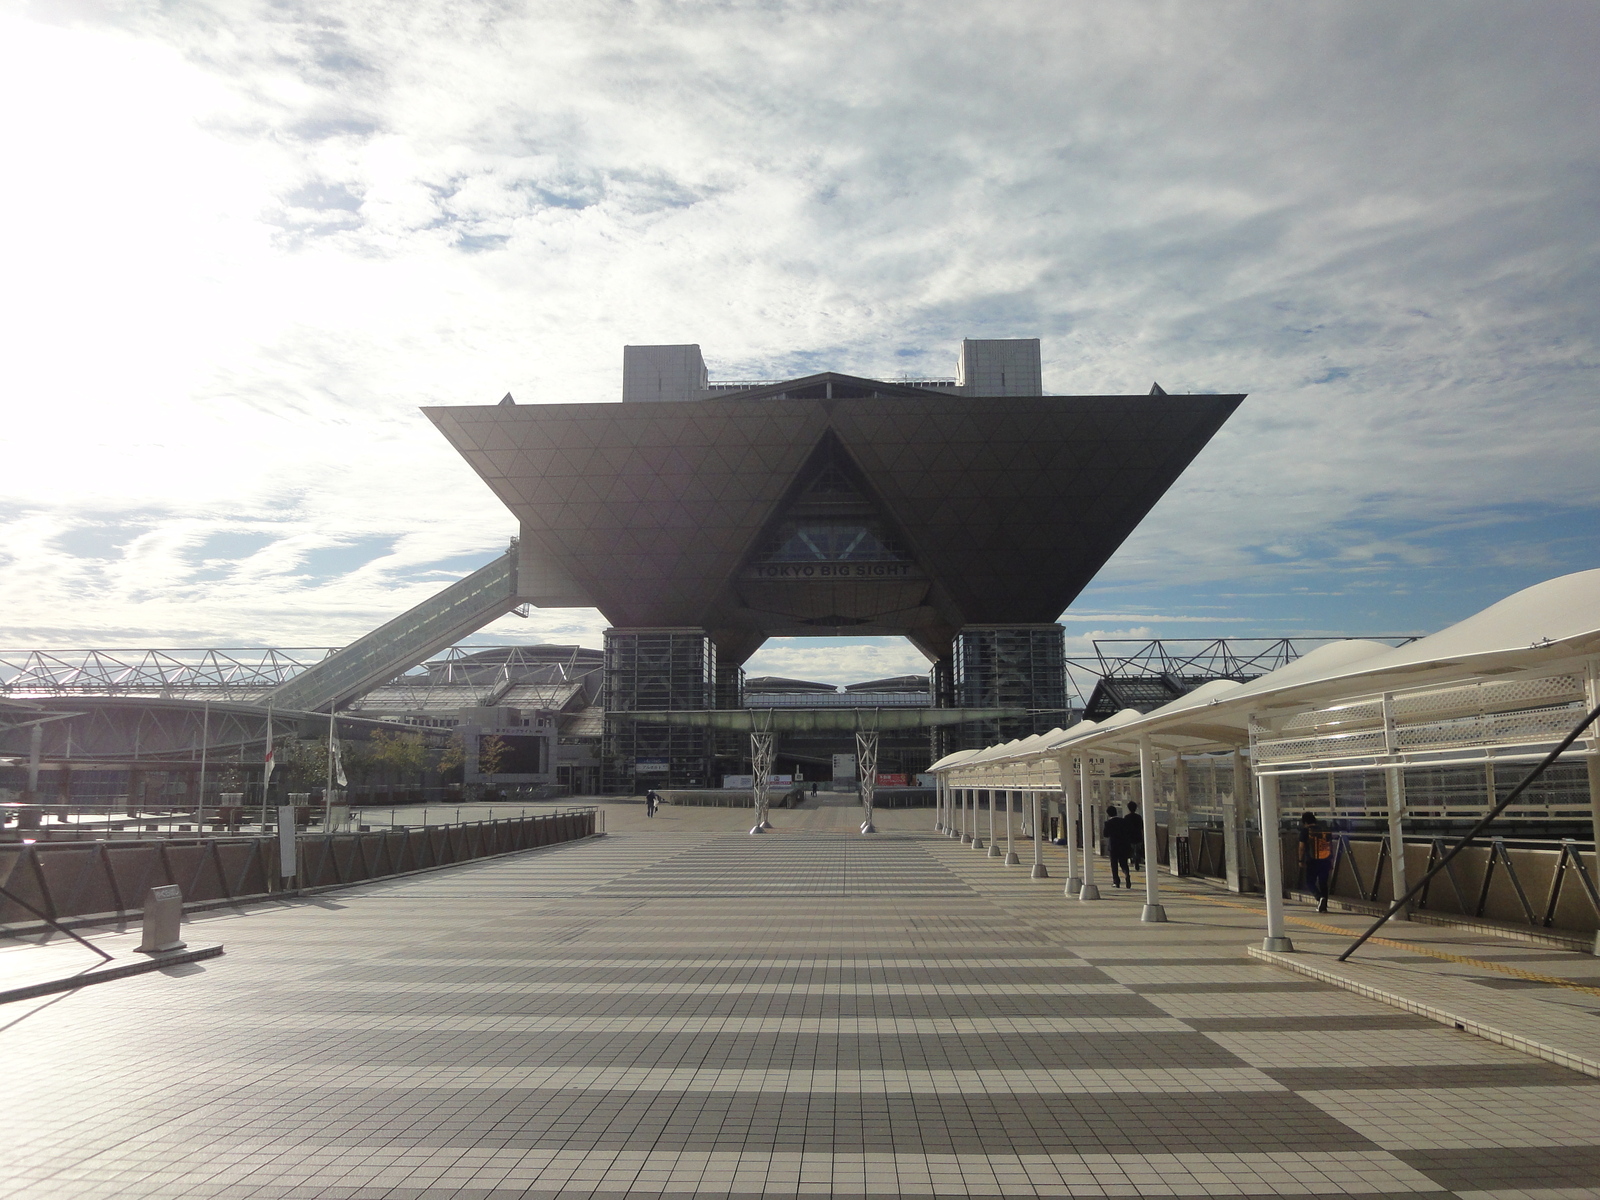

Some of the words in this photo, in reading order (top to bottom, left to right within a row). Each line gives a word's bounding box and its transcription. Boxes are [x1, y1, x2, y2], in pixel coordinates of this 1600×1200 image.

[756, 566, 815, 577] TOKYO
[820, 566, 850, 576] BIG
[856, 565, 910, 576] SIGHT
